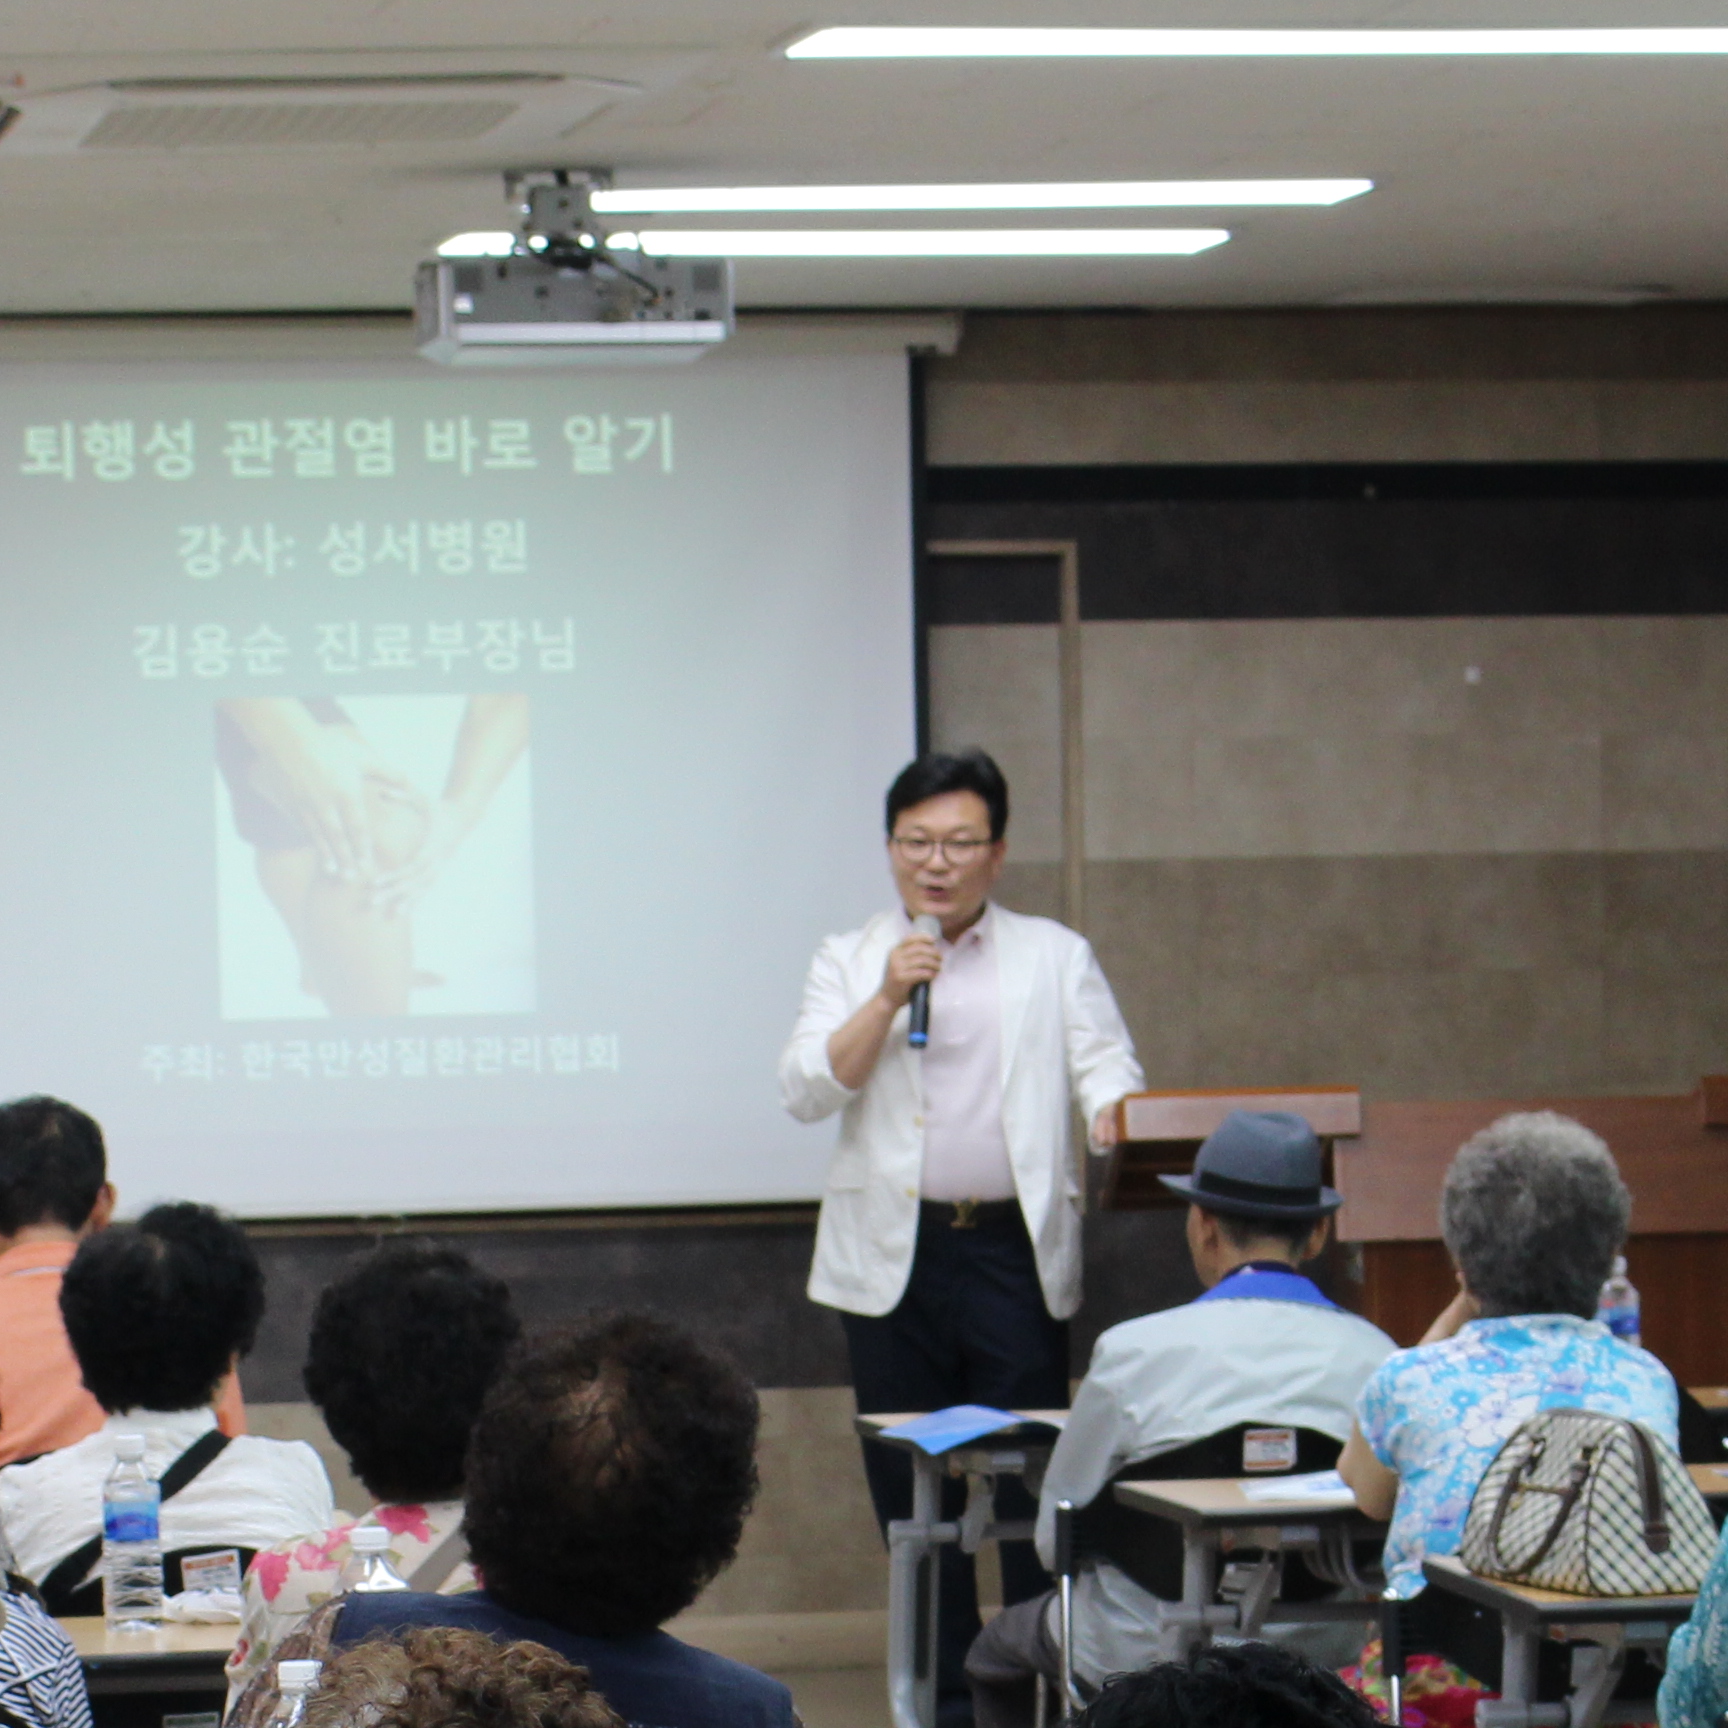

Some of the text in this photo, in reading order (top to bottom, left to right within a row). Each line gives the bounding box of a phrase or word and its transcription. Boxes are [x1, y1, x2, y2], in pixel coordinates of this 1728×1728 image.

[20, 411, 674, 481] 퇴행성 관절염 바로 알기
[177, 517, 528, 578] 강사: 성서병원
[132, 615, 578, 679] 김용순 진료부장님
[139, 1033, 620, 1084] 주최: 한국만성질환관리협회
